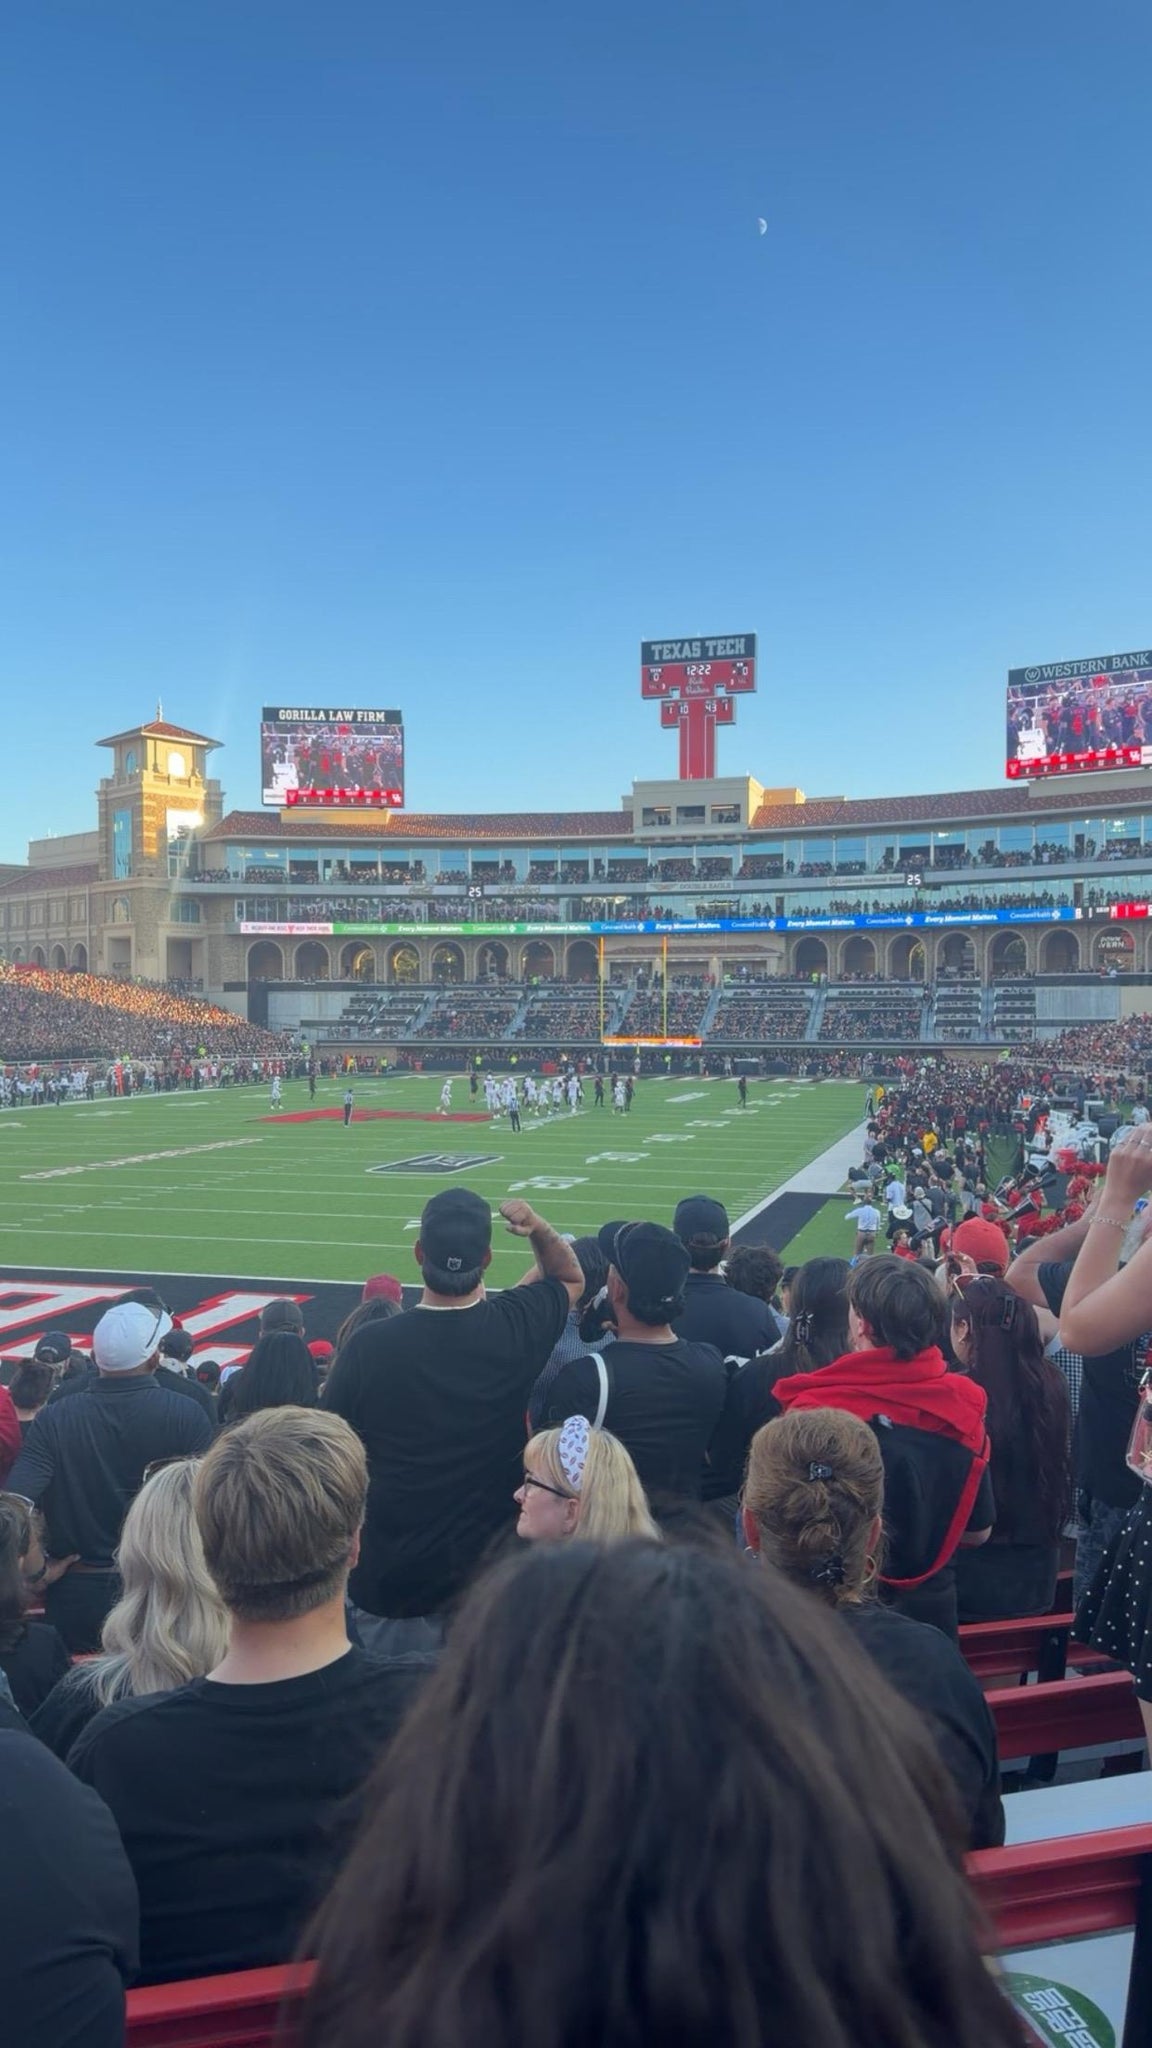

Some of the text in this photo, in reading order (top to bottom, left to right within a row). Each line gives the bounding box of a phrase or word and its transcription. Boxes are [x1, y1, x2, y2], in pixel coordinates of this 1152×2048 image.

[651, 637, 746, 661] TEXAS TECH
[687, 664, 711, 676] 12:22
[1041, 658, 1107, 678] WESTERN
[1112, 652, 1150, 669] BANK
[278, 709, 386, 722] GORILLA LAW FIRM
[907, 874, 921, 885] 25
[468, 886, 482, 897] 25
[787, 920, 805, 928] Every
[925, 915, 944, 924] Every
[655, 923, 673, 931] Every
[673, 922, 697, 930] Moment
